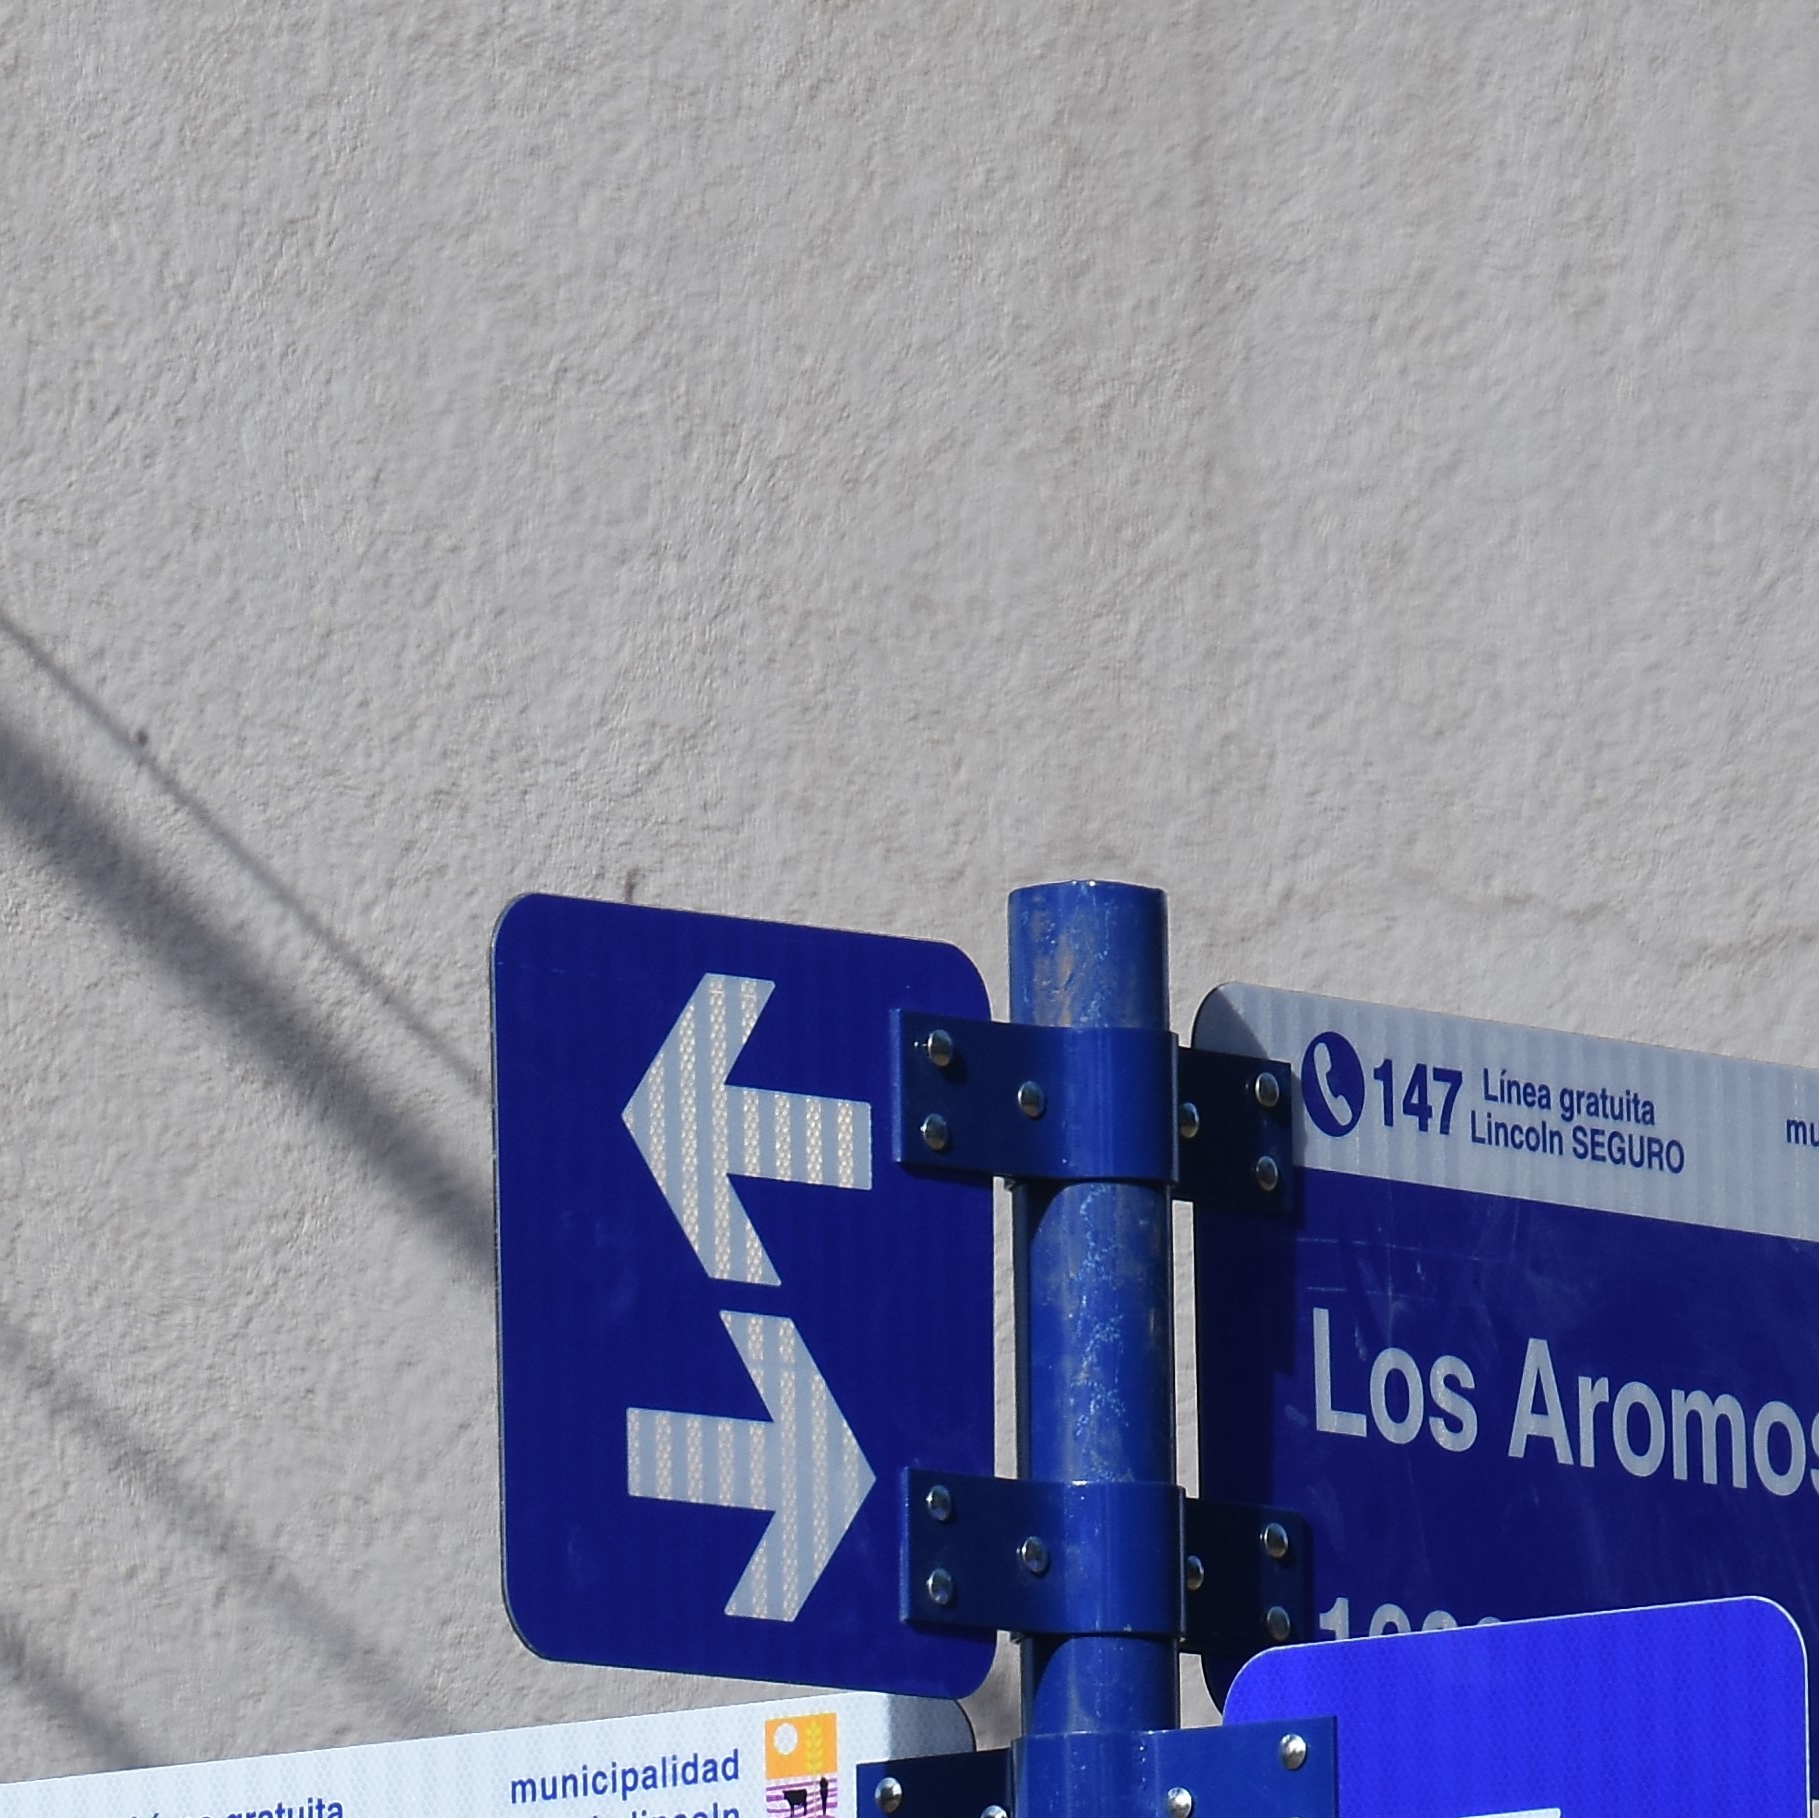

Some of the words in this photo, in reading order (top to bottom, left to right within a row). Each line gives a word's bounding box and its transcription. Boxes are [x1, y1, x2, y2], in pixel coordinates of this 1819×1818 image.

[1374, 1059, 1462, 1135] 147
[1483, 1067, 1552, 1111] Línea
[1560, 1087, 1655, 1127] gratuita
[1471, 1111, 1564, 1156] Lincoln
[1573, 1125, 1685, 1174] SEGURO
[1313, 1308, 1477, 1451] Los
[512, 1749, 740, 1806] municipalidad
